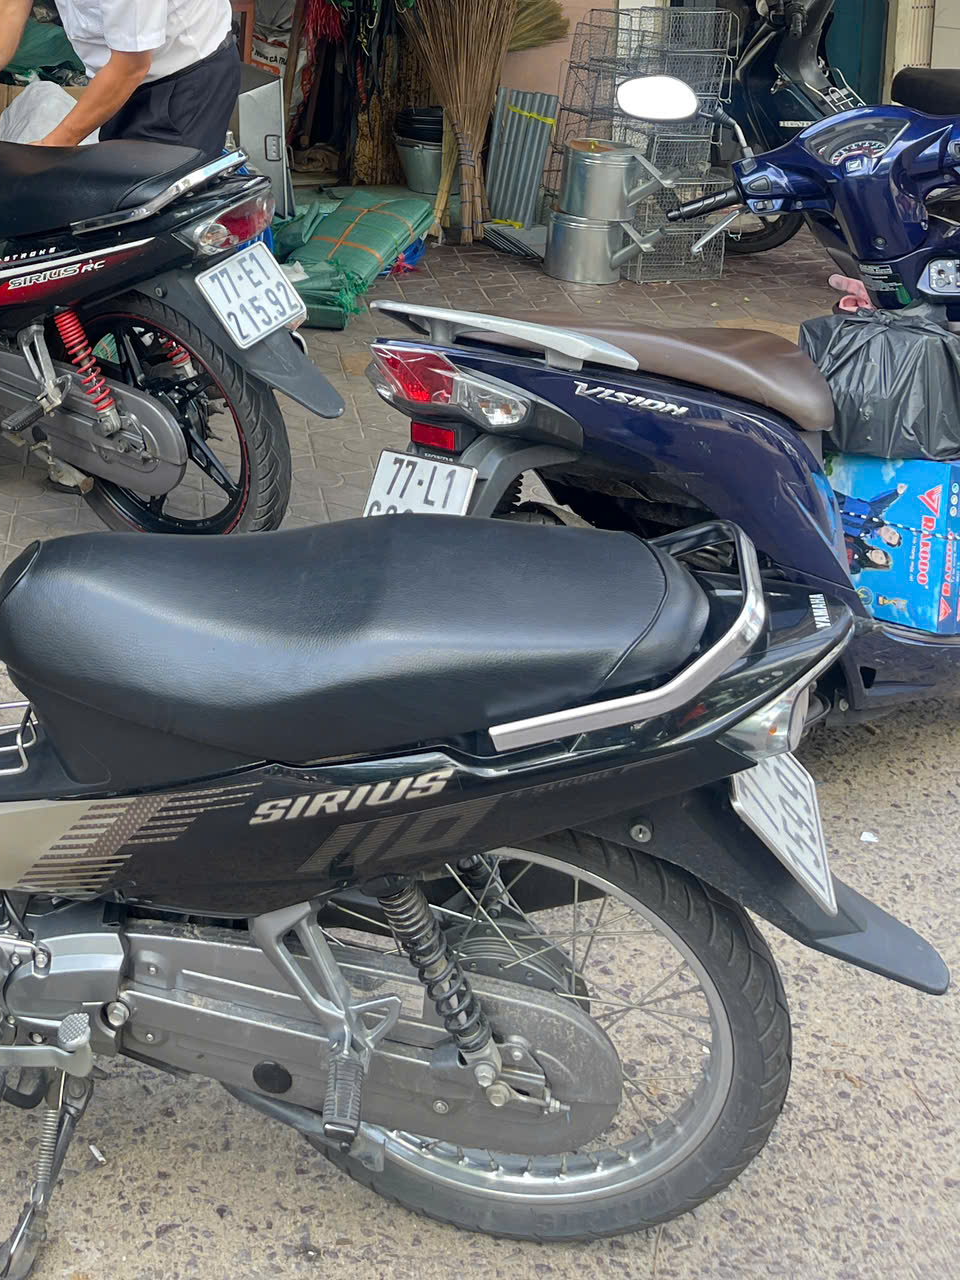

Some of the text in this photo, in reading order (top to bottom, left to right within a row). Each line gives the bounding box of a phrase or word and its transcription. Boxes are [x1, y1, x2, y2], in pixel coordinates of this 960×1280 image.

[8, 260, 106, 290] SIRIUS RC
[226, 280, 299, 340] 215.92
[573, 380, 689, 416] VISION
[808, 593, 832, 629] YAMAHA
[249, 768, 456, 826] SIRIUS
